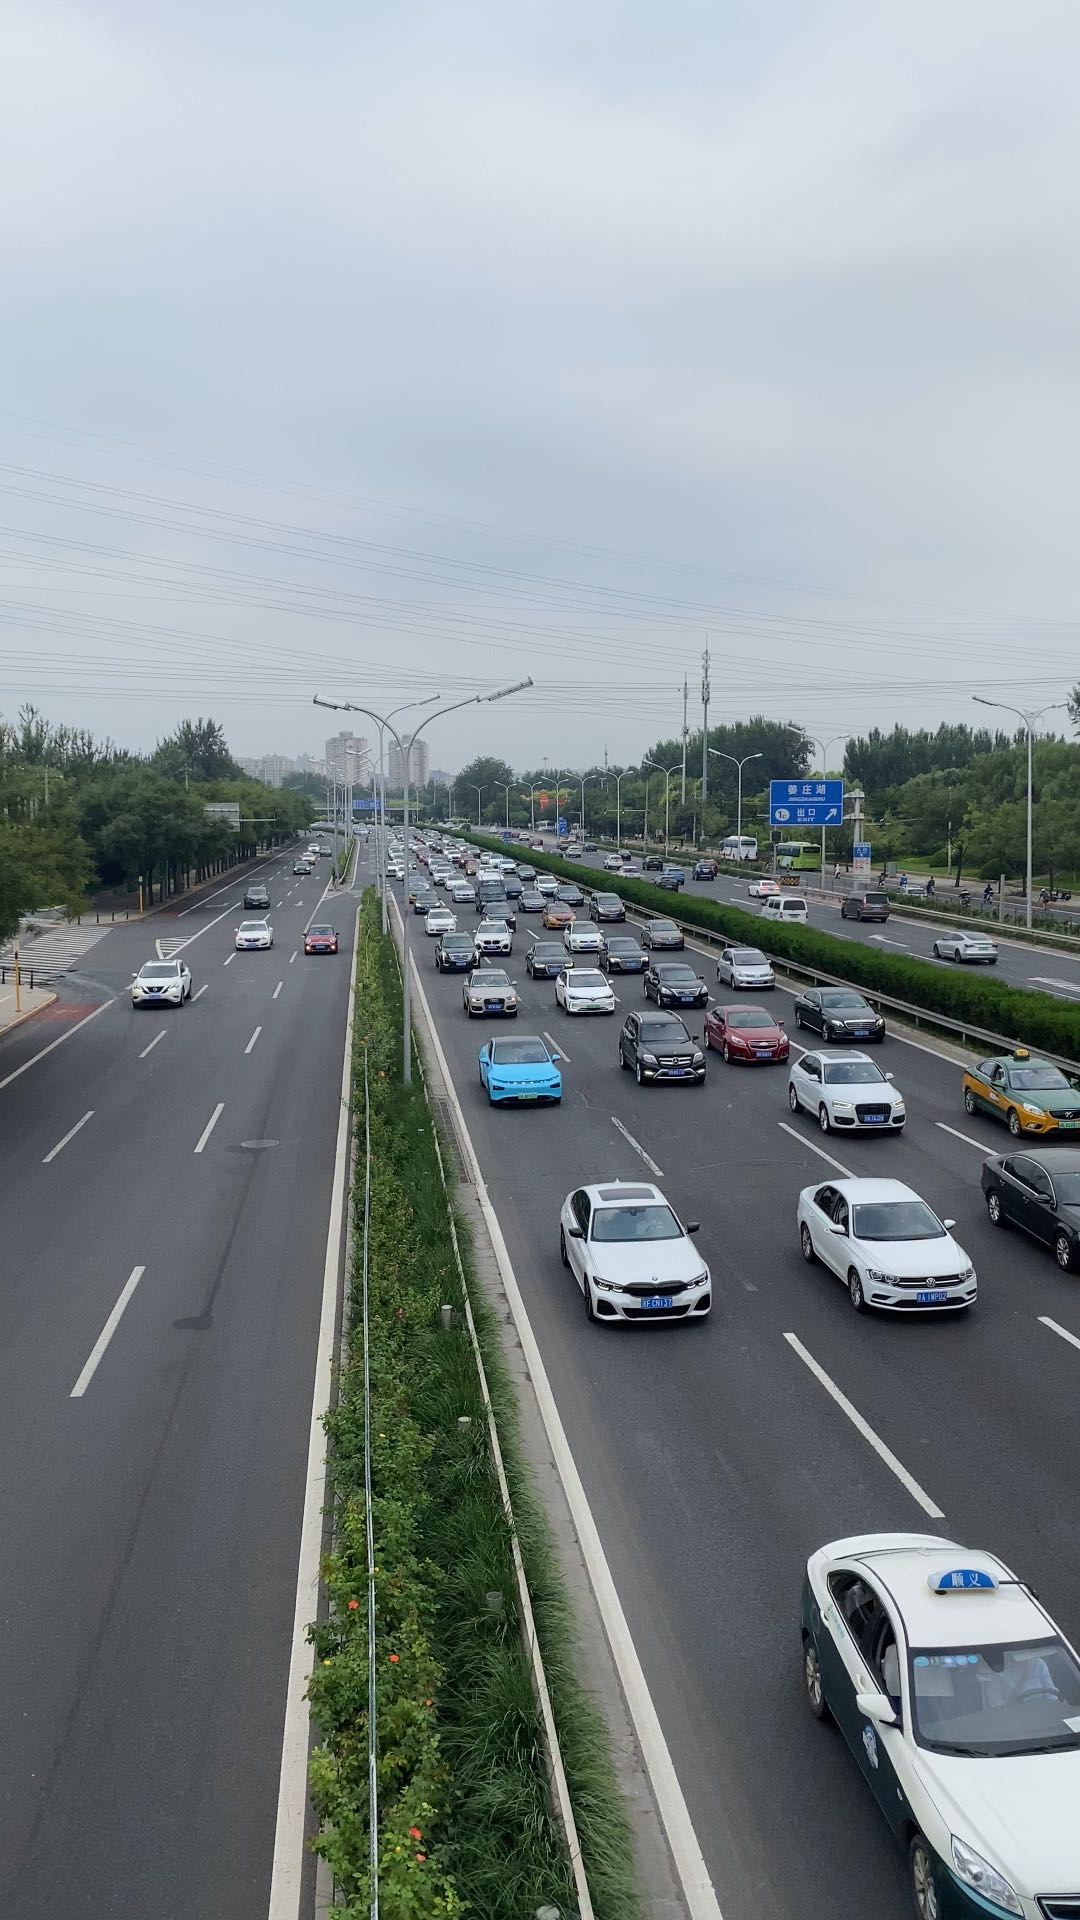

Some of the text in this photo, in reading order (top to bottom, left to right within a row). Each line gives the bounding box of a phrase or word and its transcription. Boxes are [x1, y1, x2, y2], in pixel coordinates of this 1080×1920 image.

[788, 784, 826, 795] 姜庄湖
[797, 808, 816, 817] 出口
[951, 1572, 982, 1588] 顺义
